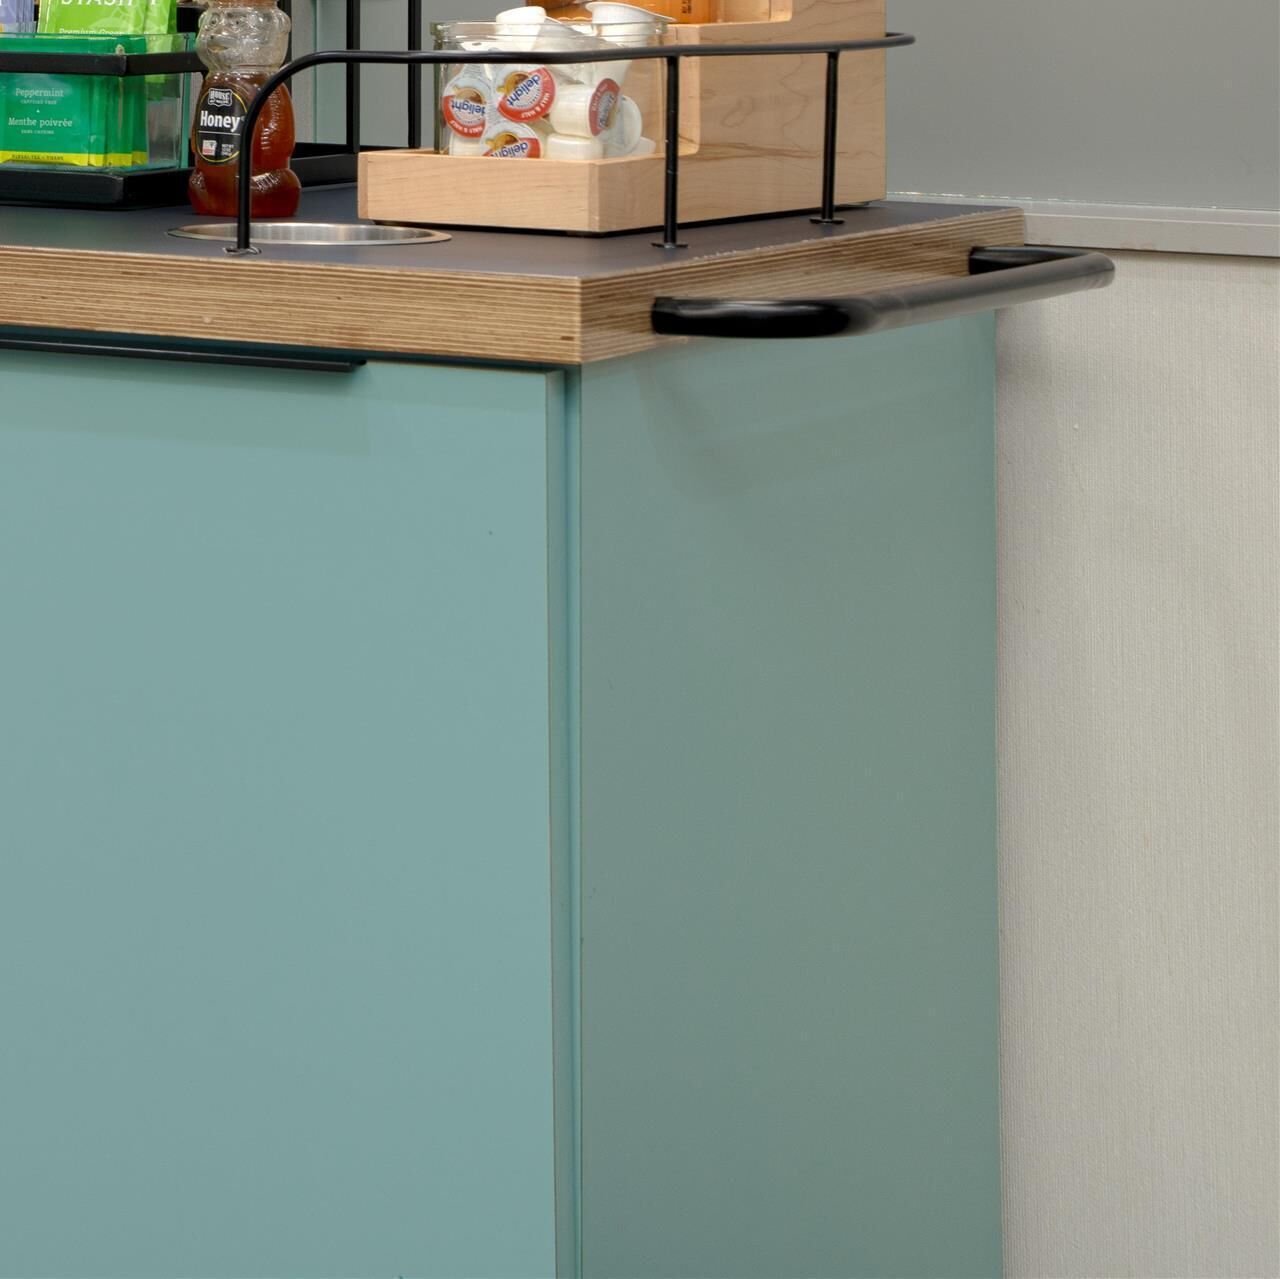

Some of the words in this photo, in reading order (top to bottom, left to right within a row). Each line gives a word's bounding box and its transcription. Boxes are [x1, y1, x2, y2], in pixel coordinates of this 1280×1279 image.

[15, 87, 64, 98] Peppermint
[506, 74, 540, 106] delight
[8, 117, 38, 126] Menthe
[200, 110, 241, 132] Honey
